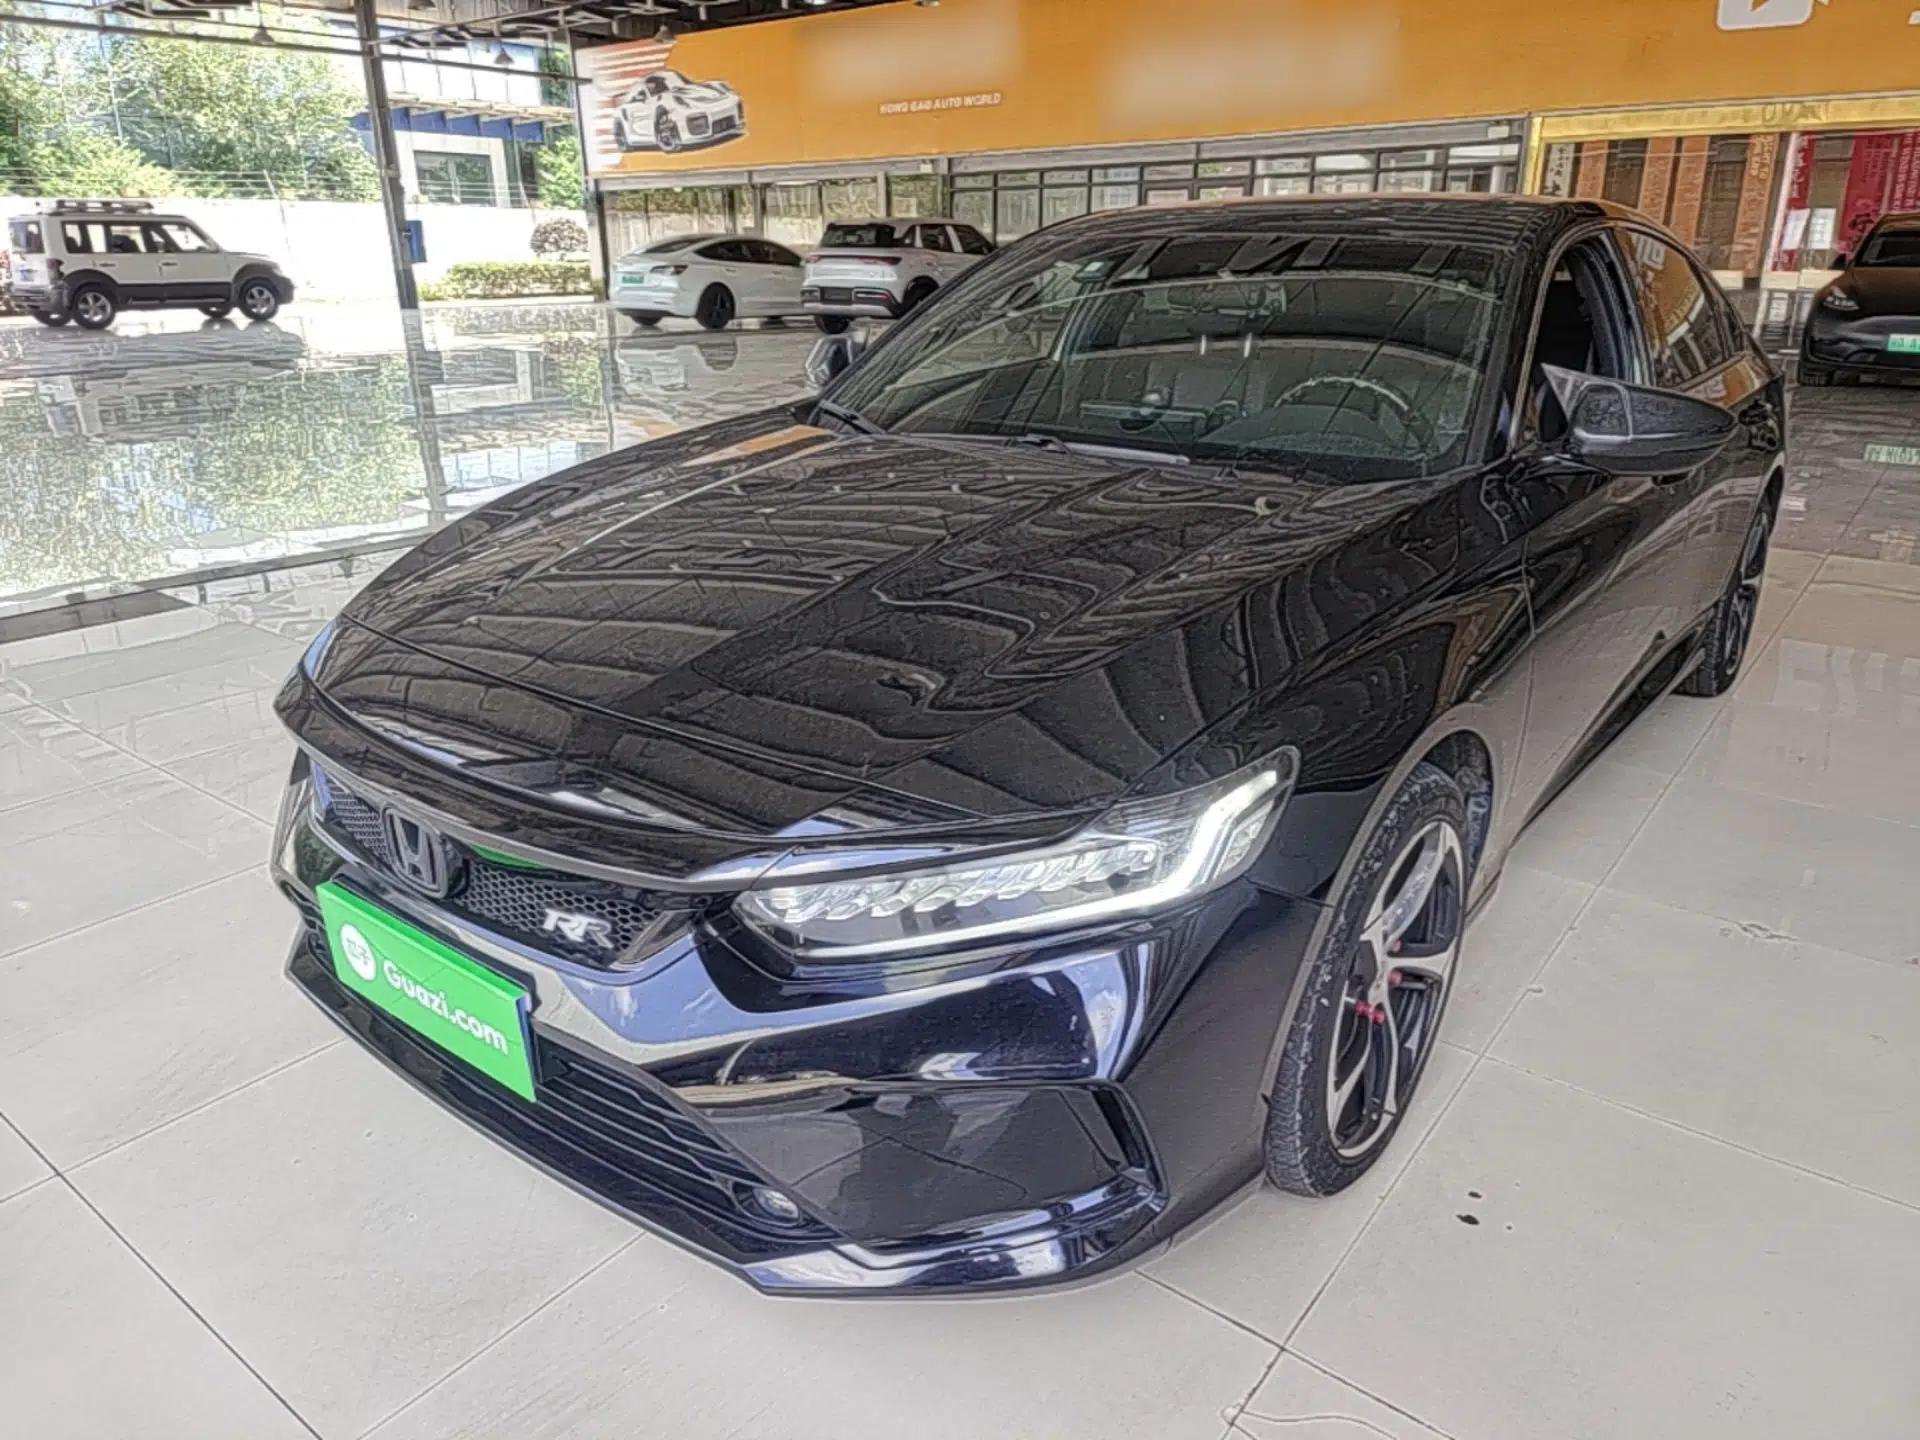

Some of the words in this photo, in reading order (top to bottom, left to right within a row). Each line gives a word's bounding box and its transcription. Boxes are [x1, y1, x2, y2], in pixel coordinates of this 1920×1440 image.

[934, 97, 962, 109] AUTO
[963, 93, 1001, 106] WORLD
[384, 959, 509, 1056] Guazi.com
